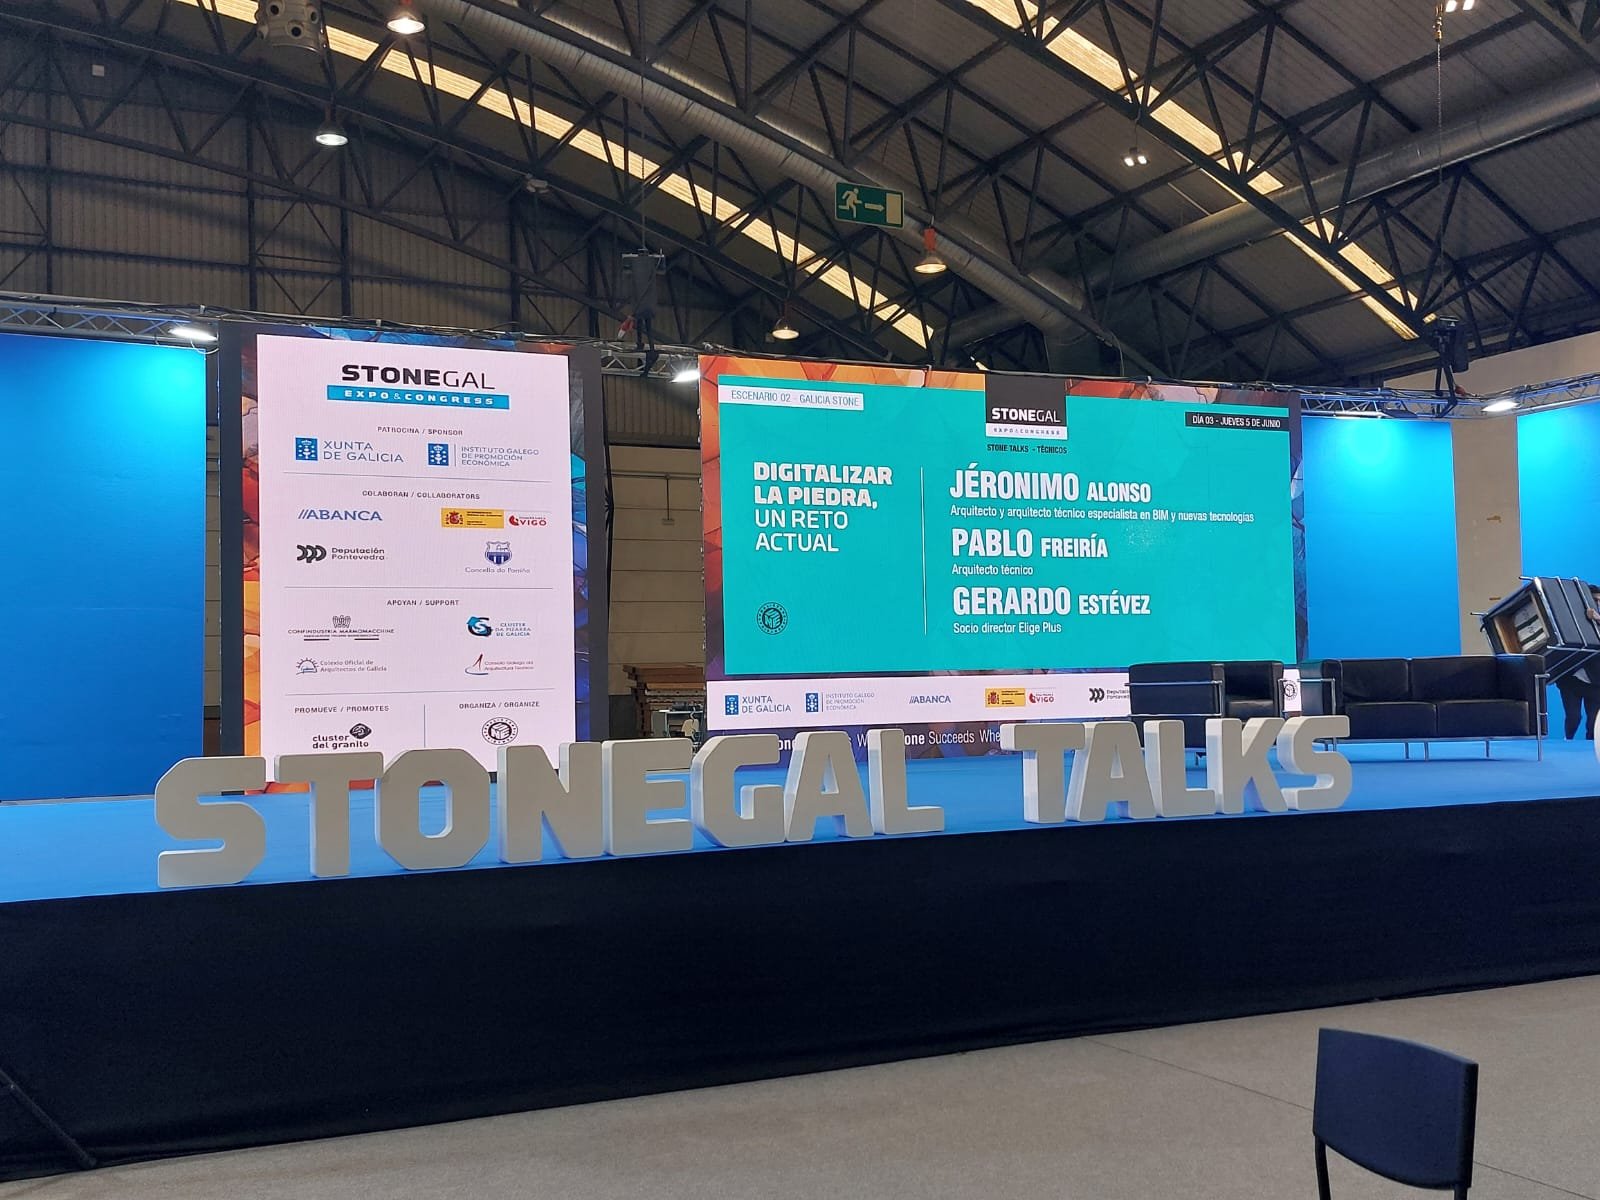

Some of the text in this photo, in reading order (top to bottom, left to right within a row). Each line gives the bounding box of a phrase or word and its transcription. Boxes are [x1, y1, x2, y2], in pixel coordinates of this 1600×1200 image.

[342, 364, 495, 390] STONEGAL
[731, 390, 778, 402] ESCENARIO
[780, 393, 791, 402] 02
[799, 394, 831, 405] GALICIA
[832, 396, 860, 407] STONE
[991, 407, 1061, 423] STONEGAL
[1192, 413, 1204, 424] DÍA
[1205, 415, 1214, 425] 03
[1220, 416, 1245, 426] JUEVES
[1245, 418, 1251, 427] 5
[1251, 418, 1261, 427] DE
[1262, 419, 1281, 428] JUNIO
[377, 426, 420, 434] PATROCINA
[428, 428, 463, 436] SPONSOR
[323, 440, 374, 451] XUNTA
[461, 446, 539, 456] INSTITUTO GALEGO
[987, 443, 1009, 452] STONE
[1009, 444, 1029, 453] TALKS
[323, 451, 404, 463] DE GALICIA
[474, 453, 523, 461] PROMOCIÓN
[753, 461, 893, 485] DIGITALIZAR
[949, 462, 1152, 503] JÉRONIMO ALONSO
[362, 490, 409, 498] COLABORAN
[416, 491, 481, 500] COLLABORATORS
[754, 486, 878, 510] LA PIEDRA,
[755, 509, 849, 530] UN RETO
[950, 505, 1255, 524] Arquitecto y arquitecto técnico especialista en BIM y nuevas tecnologías
[755, 532, 840, 552] ACTUAL
[951, 528, 1109, 558] PABLO FREIRÍA
[331, 547, 385, 555] Deputación
[951, 563, 1034, 577] Arquitecto técnico
[953, 586, 1151, 616] GERARDO ESTÉVEZ
[953, 621, 1062, 635] Socio director Elige Plus
[742, 695, 773, 704] XUNTA
[294, 706, 338, 714] PROMUEVE
[742, 703, 792, 714] DE GALICIA
[312, 734, 350, 742] cluster
[928, 730, 975, 745] Succeeds
[331, 740, 369, 750] granito
[1000, 714, 1353, 824] TALKS
[154, 727, 945, 889] STONEGAL
